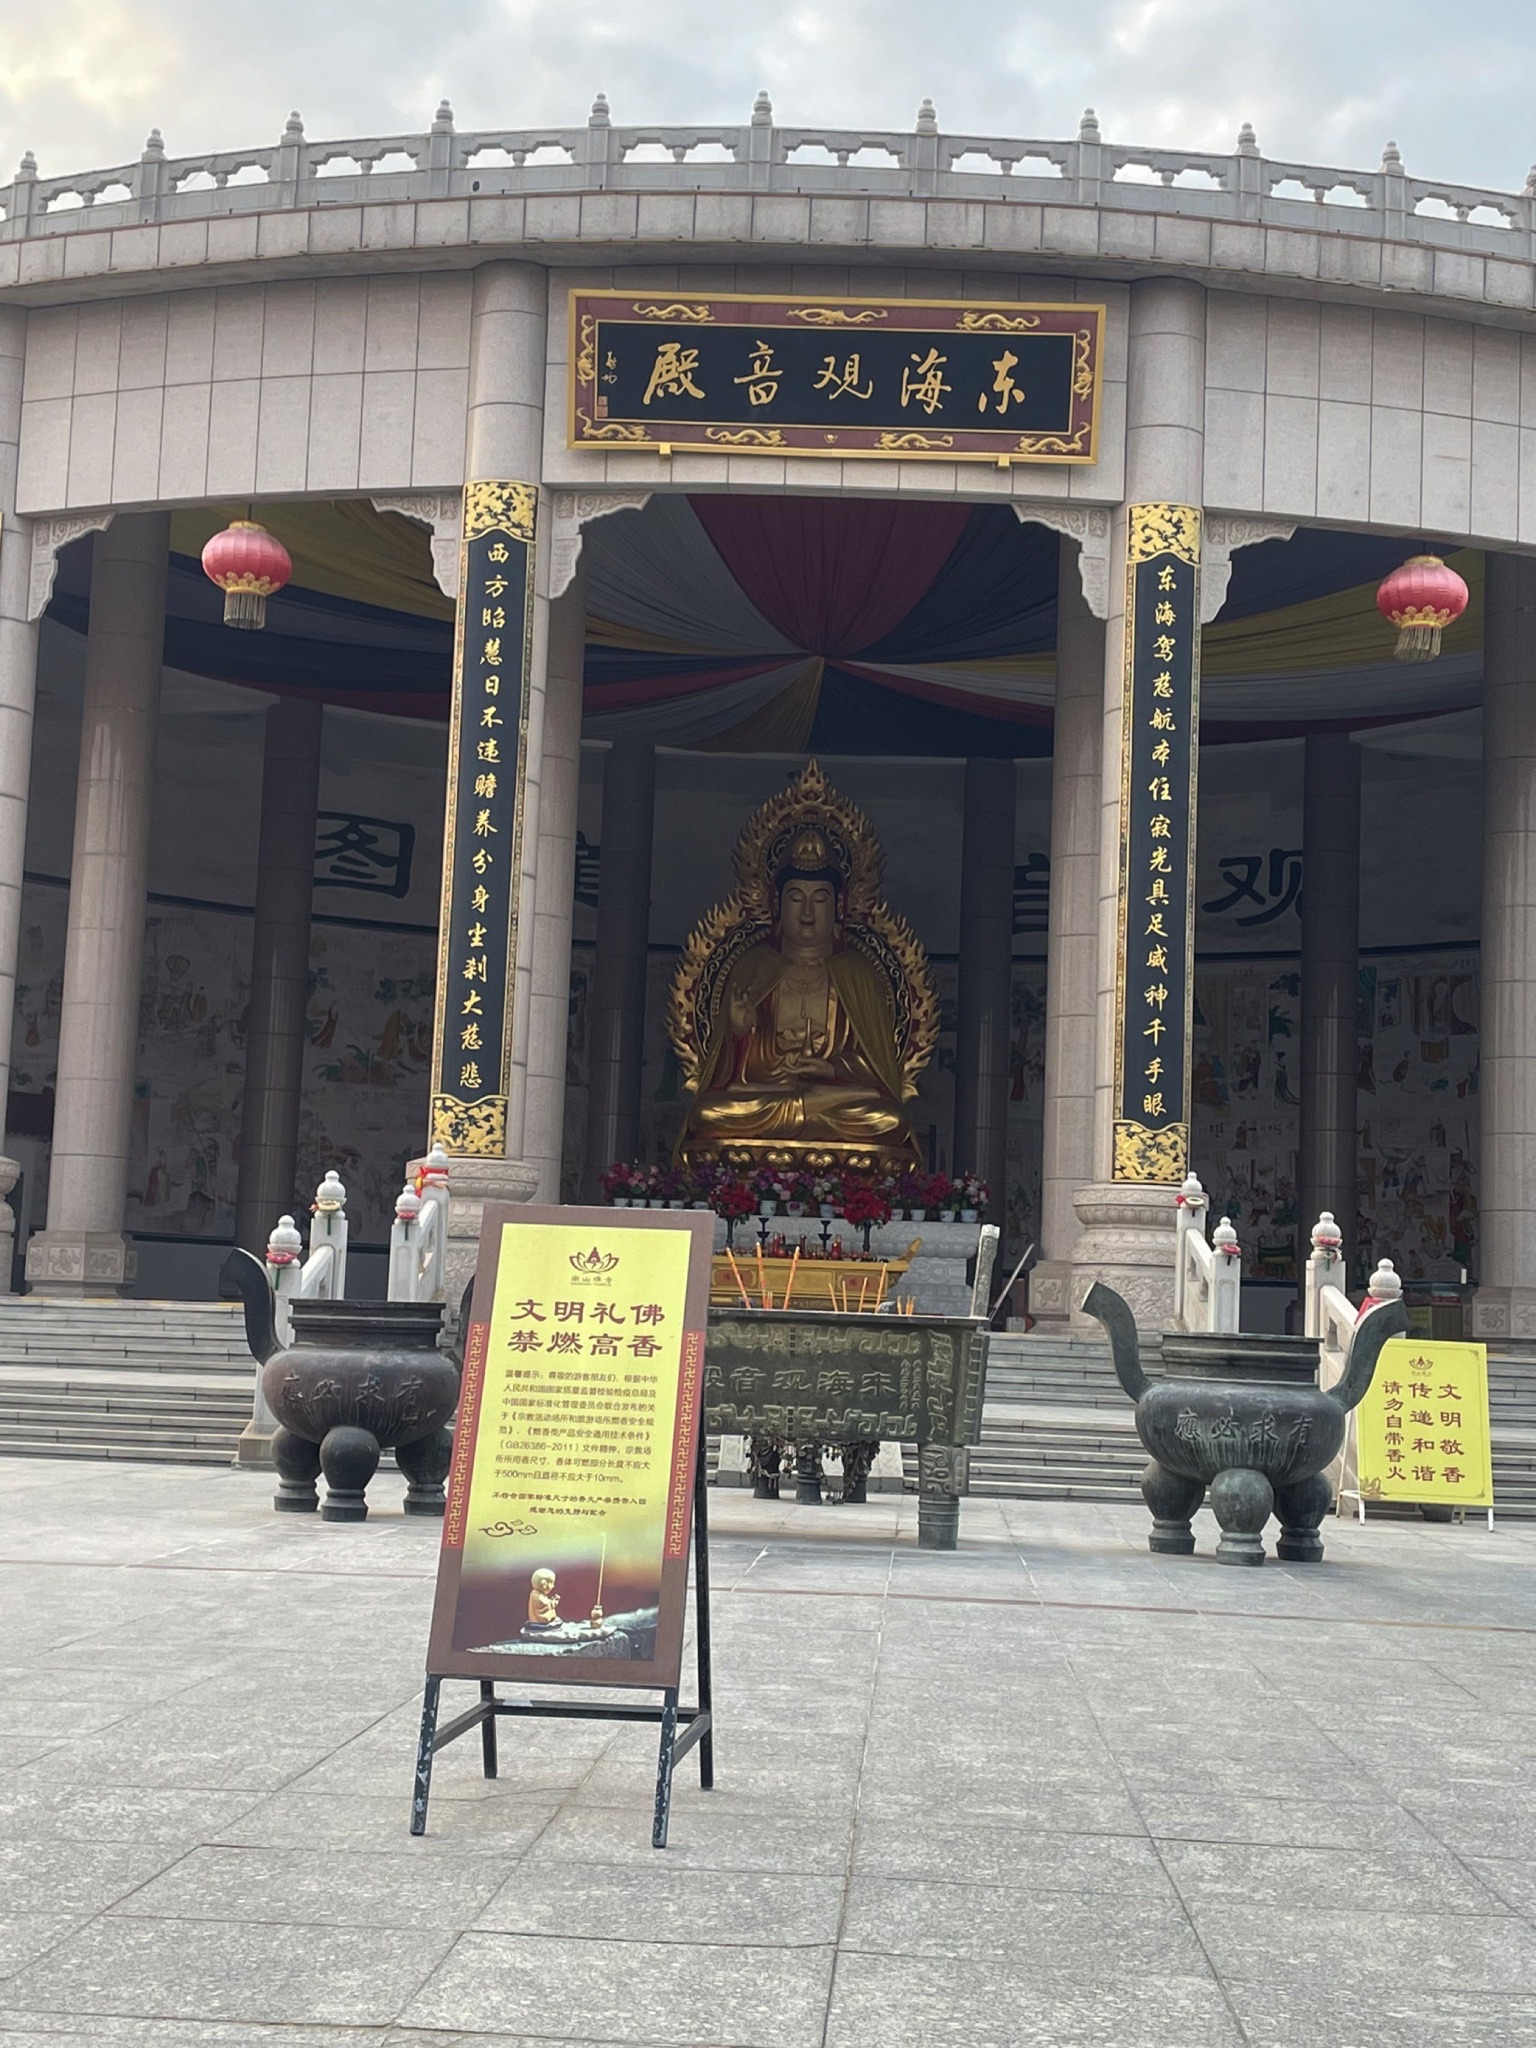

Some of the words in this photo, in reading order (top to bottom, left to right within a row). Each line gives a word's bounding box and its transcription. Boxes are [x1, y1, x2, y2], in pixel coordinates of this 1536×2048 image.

[642, 340, 1026, 414] 东海观音殿
[506, 1329, 664, 1359] 禁燃高香
[509, 1298, 666, 1327] 文明礼佛
[1382, 1380, 1407, 1481] 请勿自带香火
[1407, 1382, 1436, 1482] 传递和谐
[1437, 1383, 1466, 1483] 文明敬香
